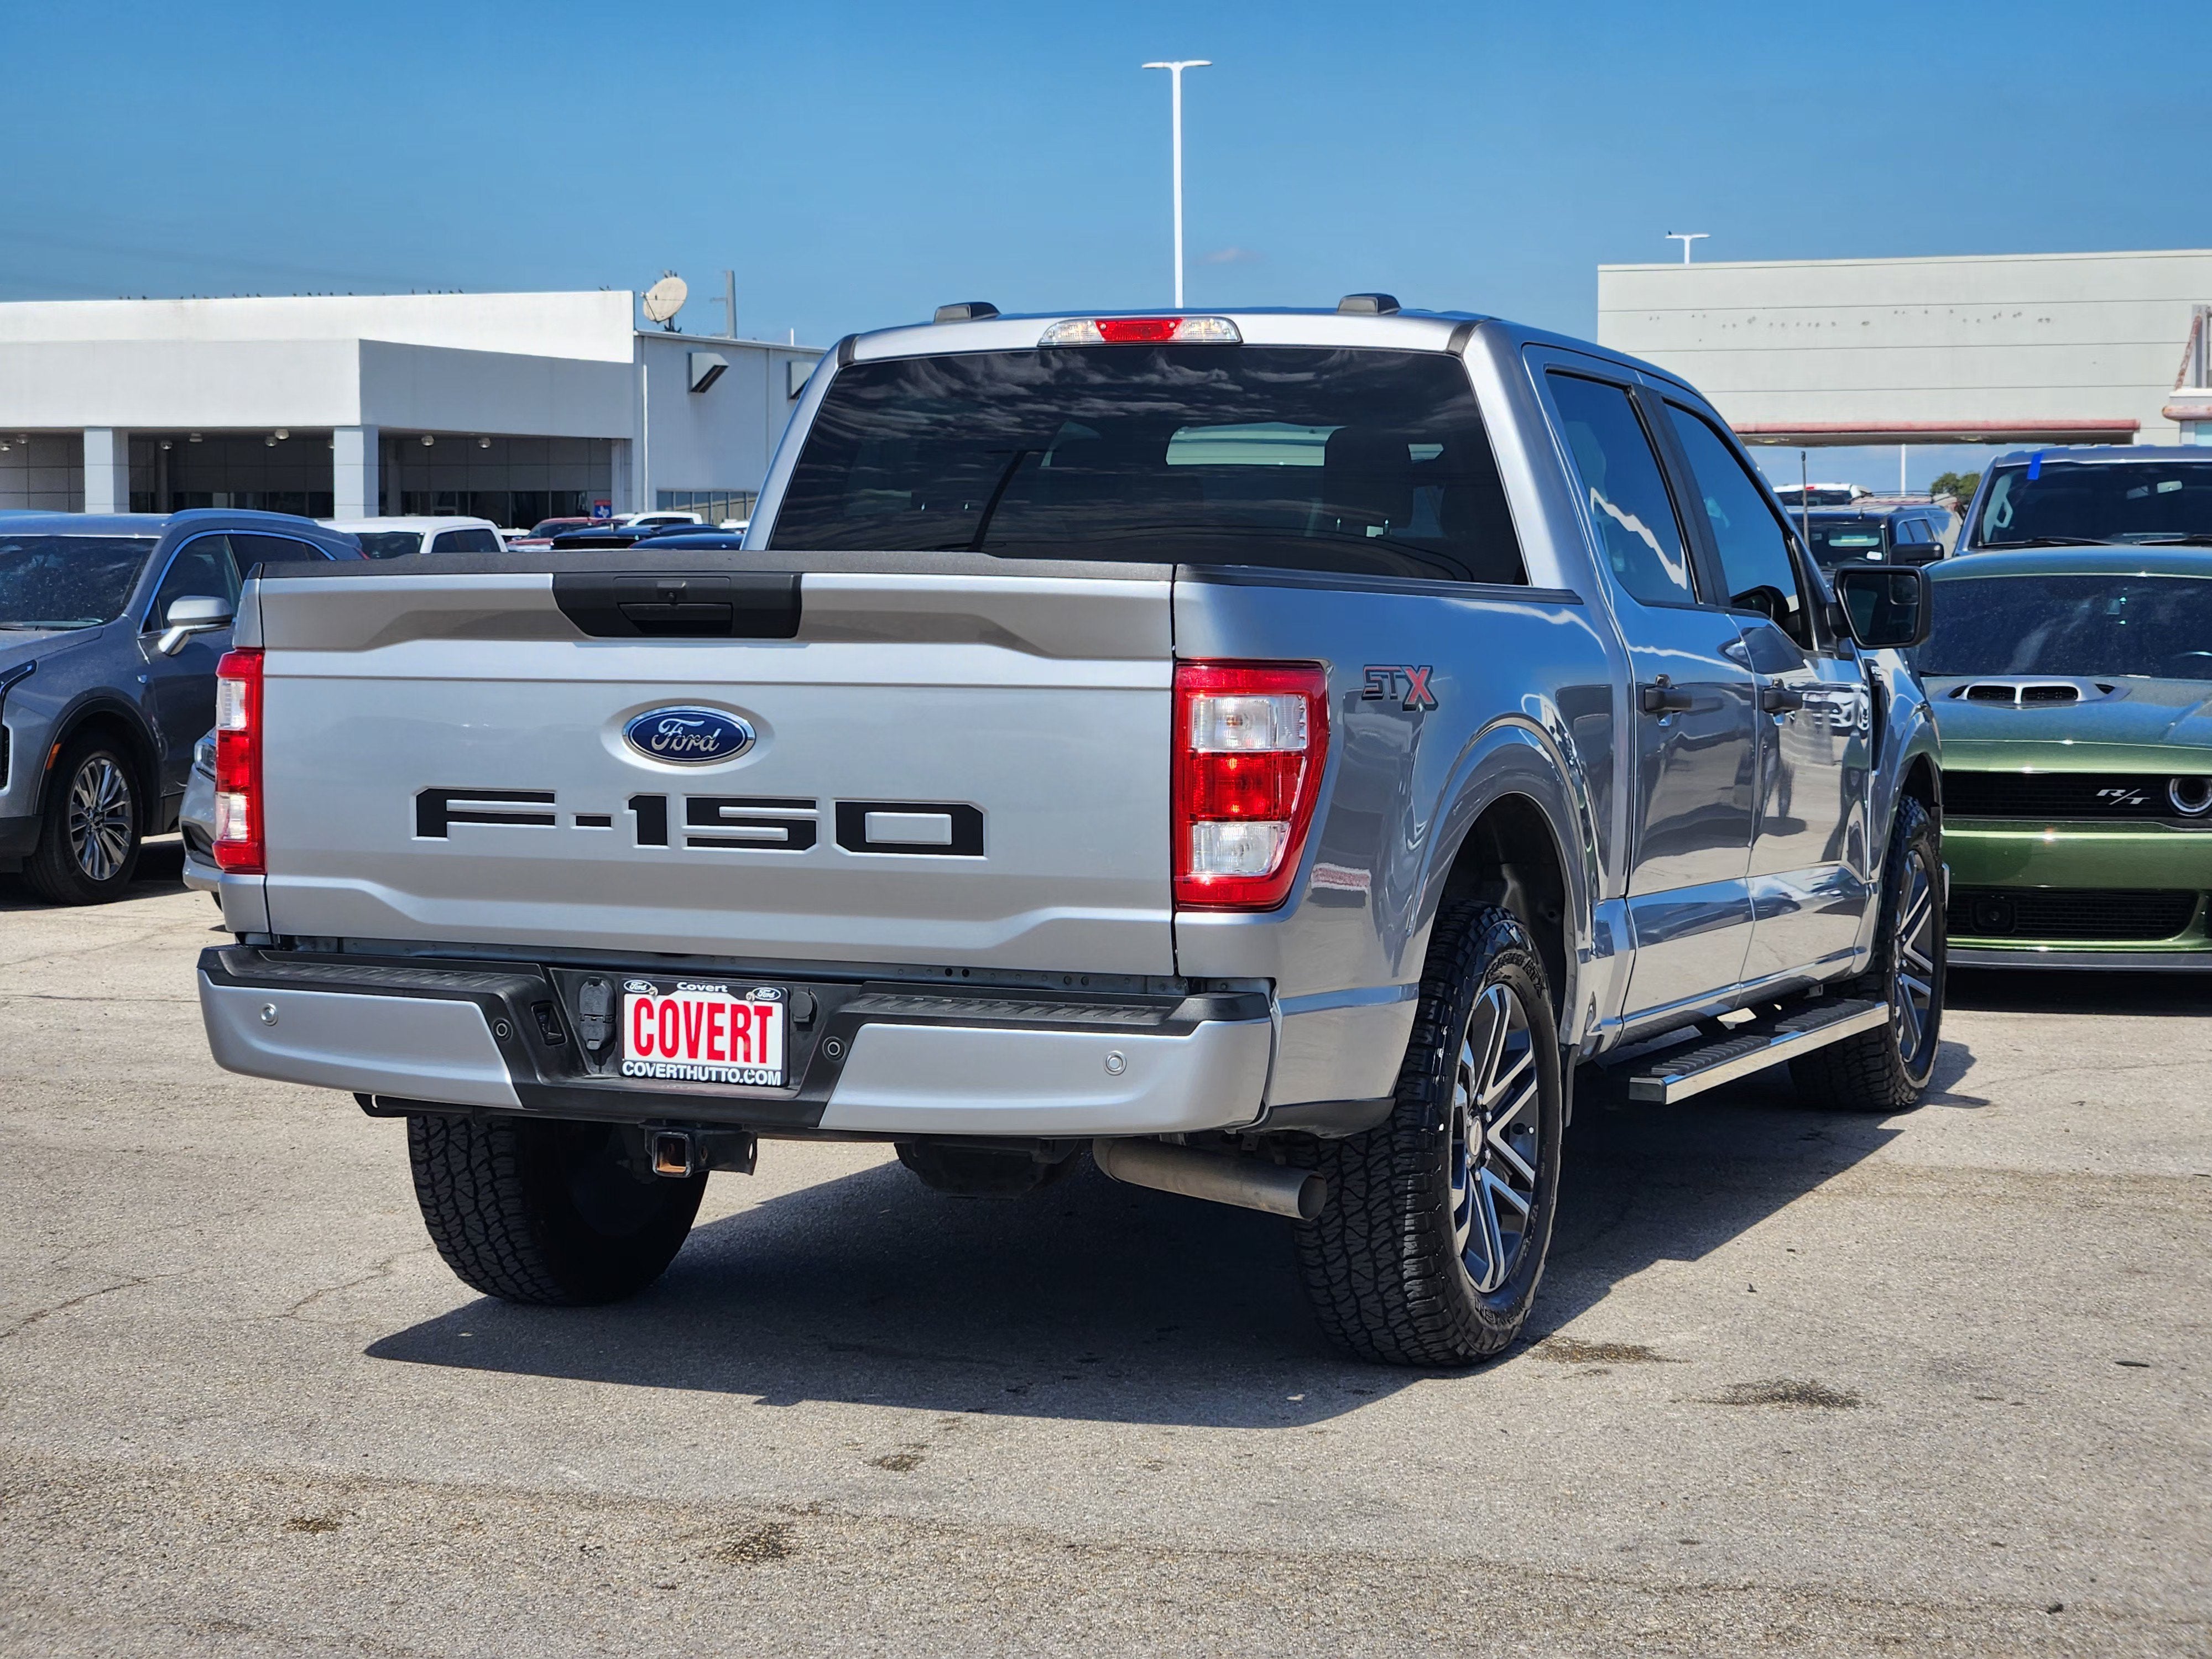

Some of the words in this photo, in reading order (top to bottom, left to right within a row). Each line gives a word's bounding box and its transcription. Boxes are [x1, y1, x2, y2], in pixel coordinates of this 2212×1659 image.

[1361, 664, 1438, 712] STX
[651, 718, 722, 752] Ford
[2096, 789, 2151, 805] R/T
[413, 786, 987, 859] F-150
[629, 982, 648, 990] Ford
[676, 982, 728, 993] Covert
[757, 989, 775, 998] Ford
[633, 997, 774, 1064] COVERT
[622, 1061, 781, 1086] COVERTHUTTO.COM
